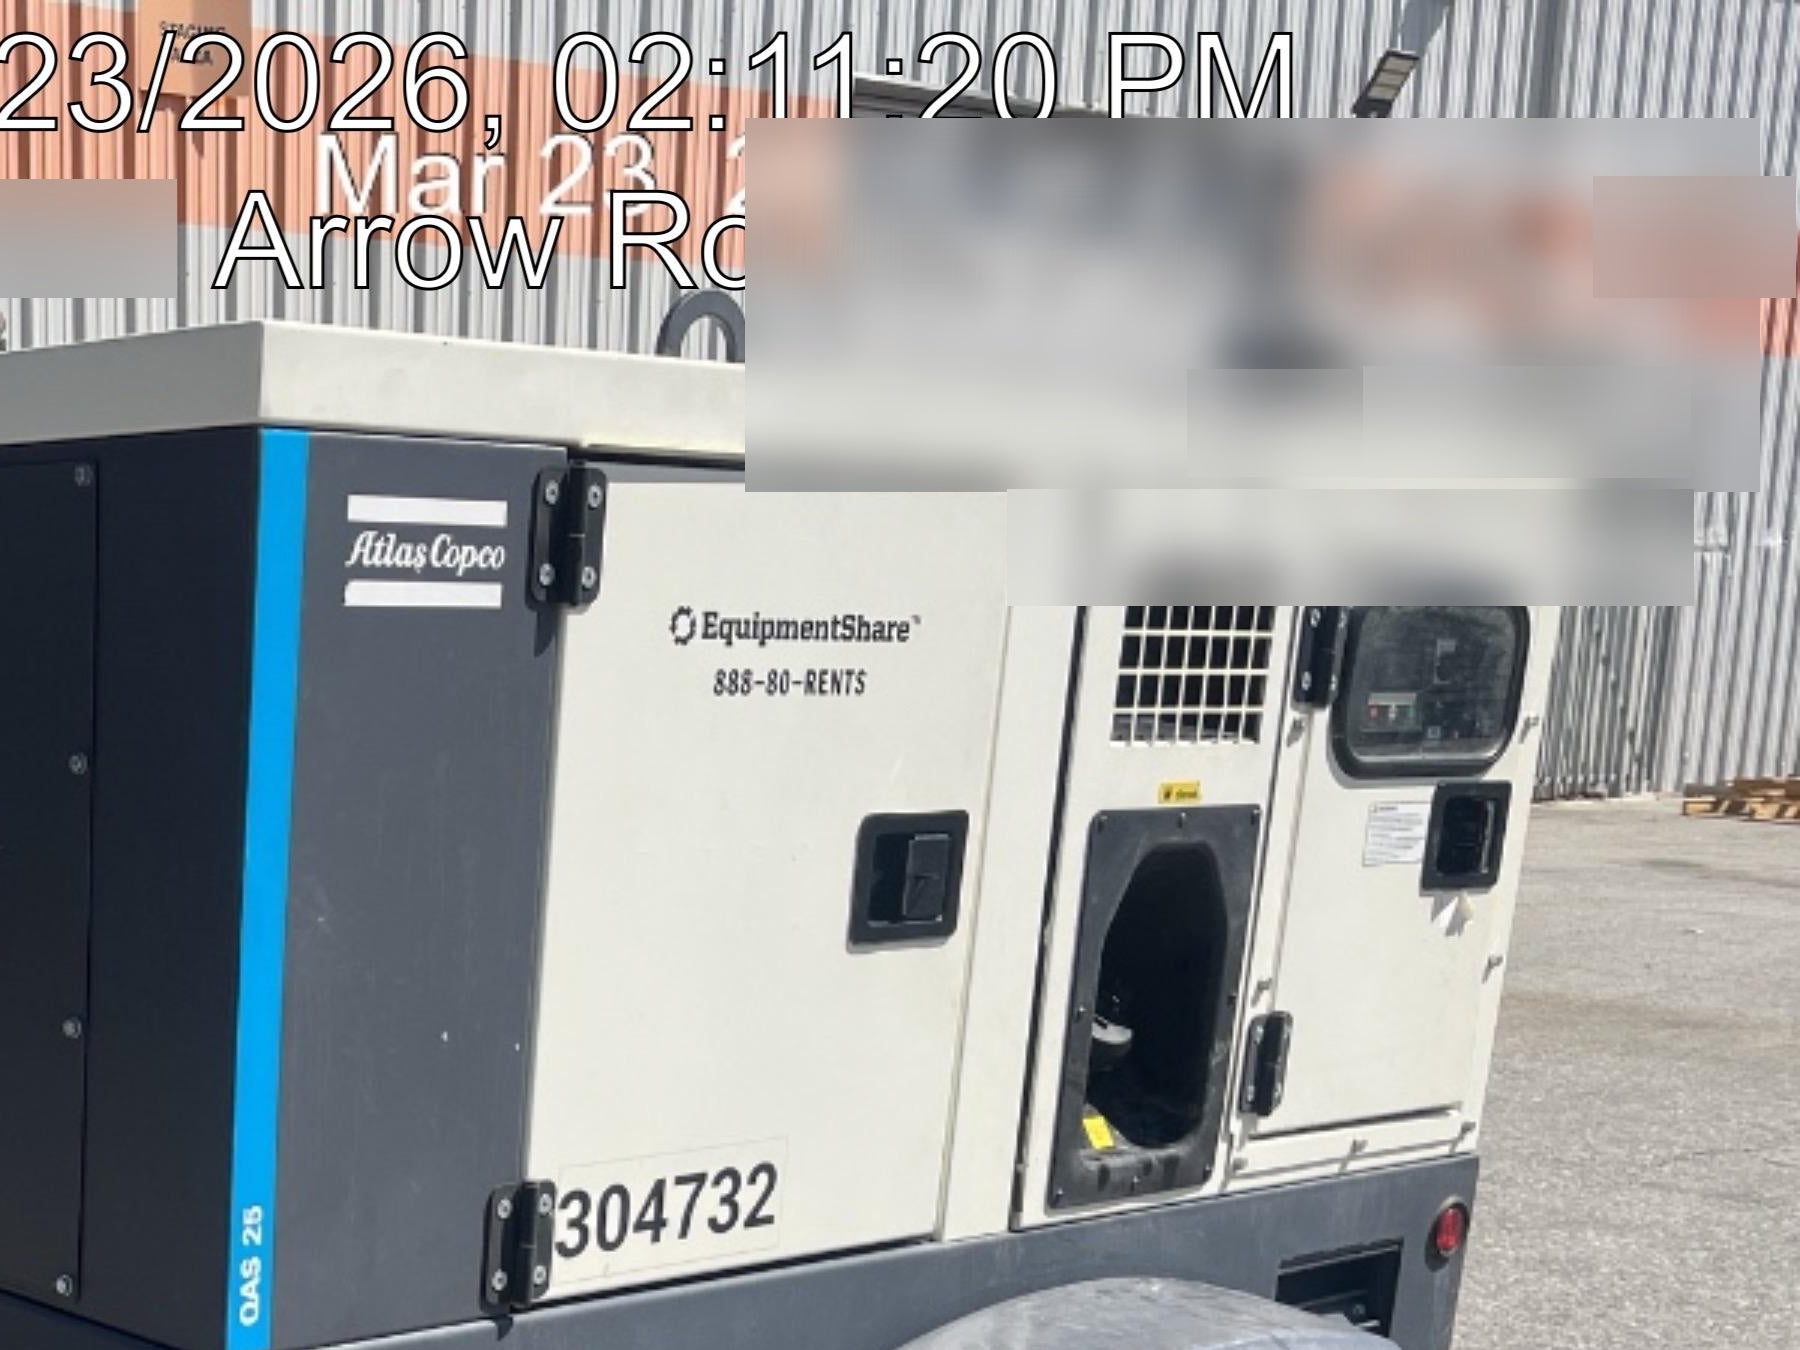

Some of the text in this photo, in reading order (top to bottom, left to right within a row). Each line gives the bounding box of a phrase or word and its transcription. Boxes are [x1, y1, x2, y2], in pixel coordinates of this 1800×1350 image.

[344, 529, 506, 577] Atlas Copco
[701, 610, 912, 648] EquipmentShare
[713, 668, 868, 698] 888-80-RENTS
[554, 1160, 778, 1259] 304732
[238, 1204, 264, 1328] QAS 25
